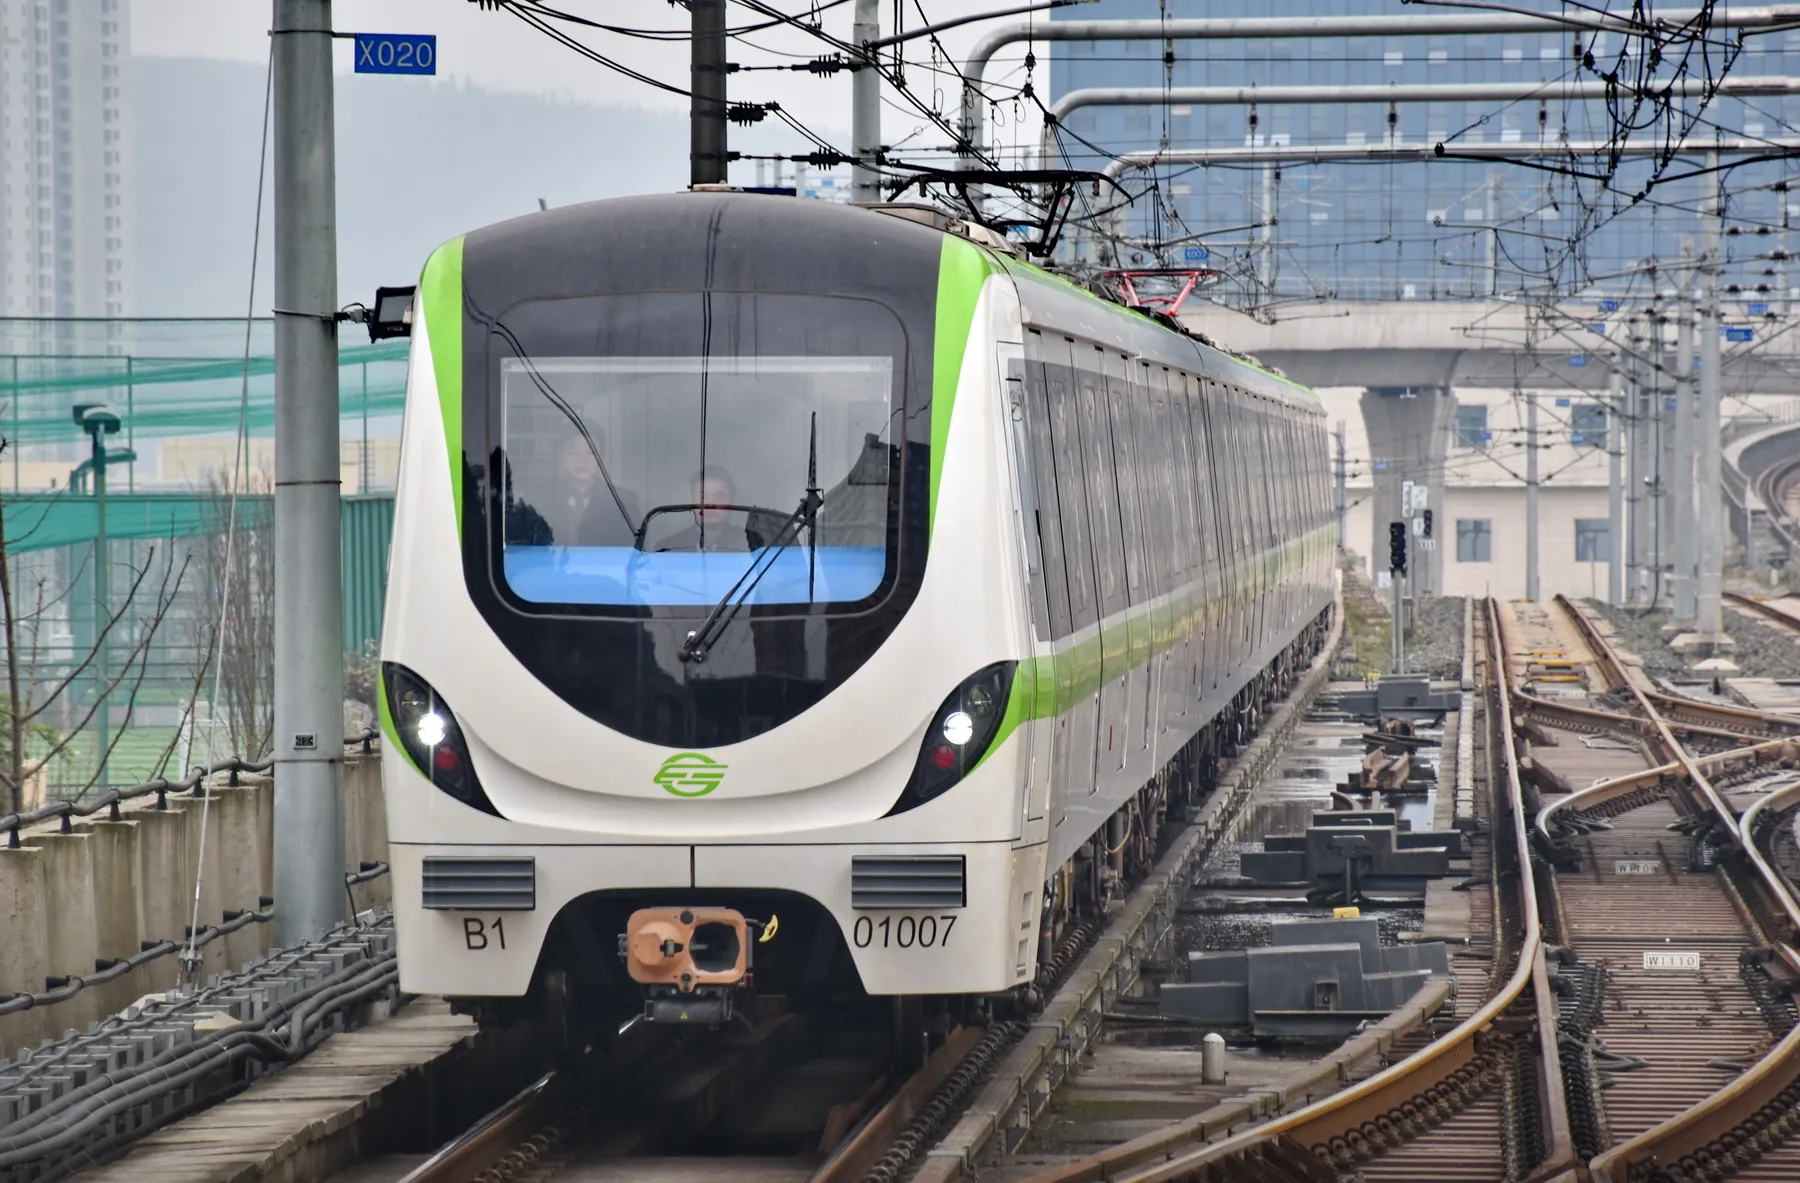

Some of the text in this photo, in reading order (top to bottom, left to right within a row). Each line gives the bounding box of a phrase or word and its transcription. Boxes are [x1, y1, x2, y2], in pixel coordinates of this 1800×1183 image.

[359, 40, 433, 67] X020
[463, 916, 506, 950] B1
[853, 915, 958, 948] 01007
[1649, 956, 1695, 966] W1110
